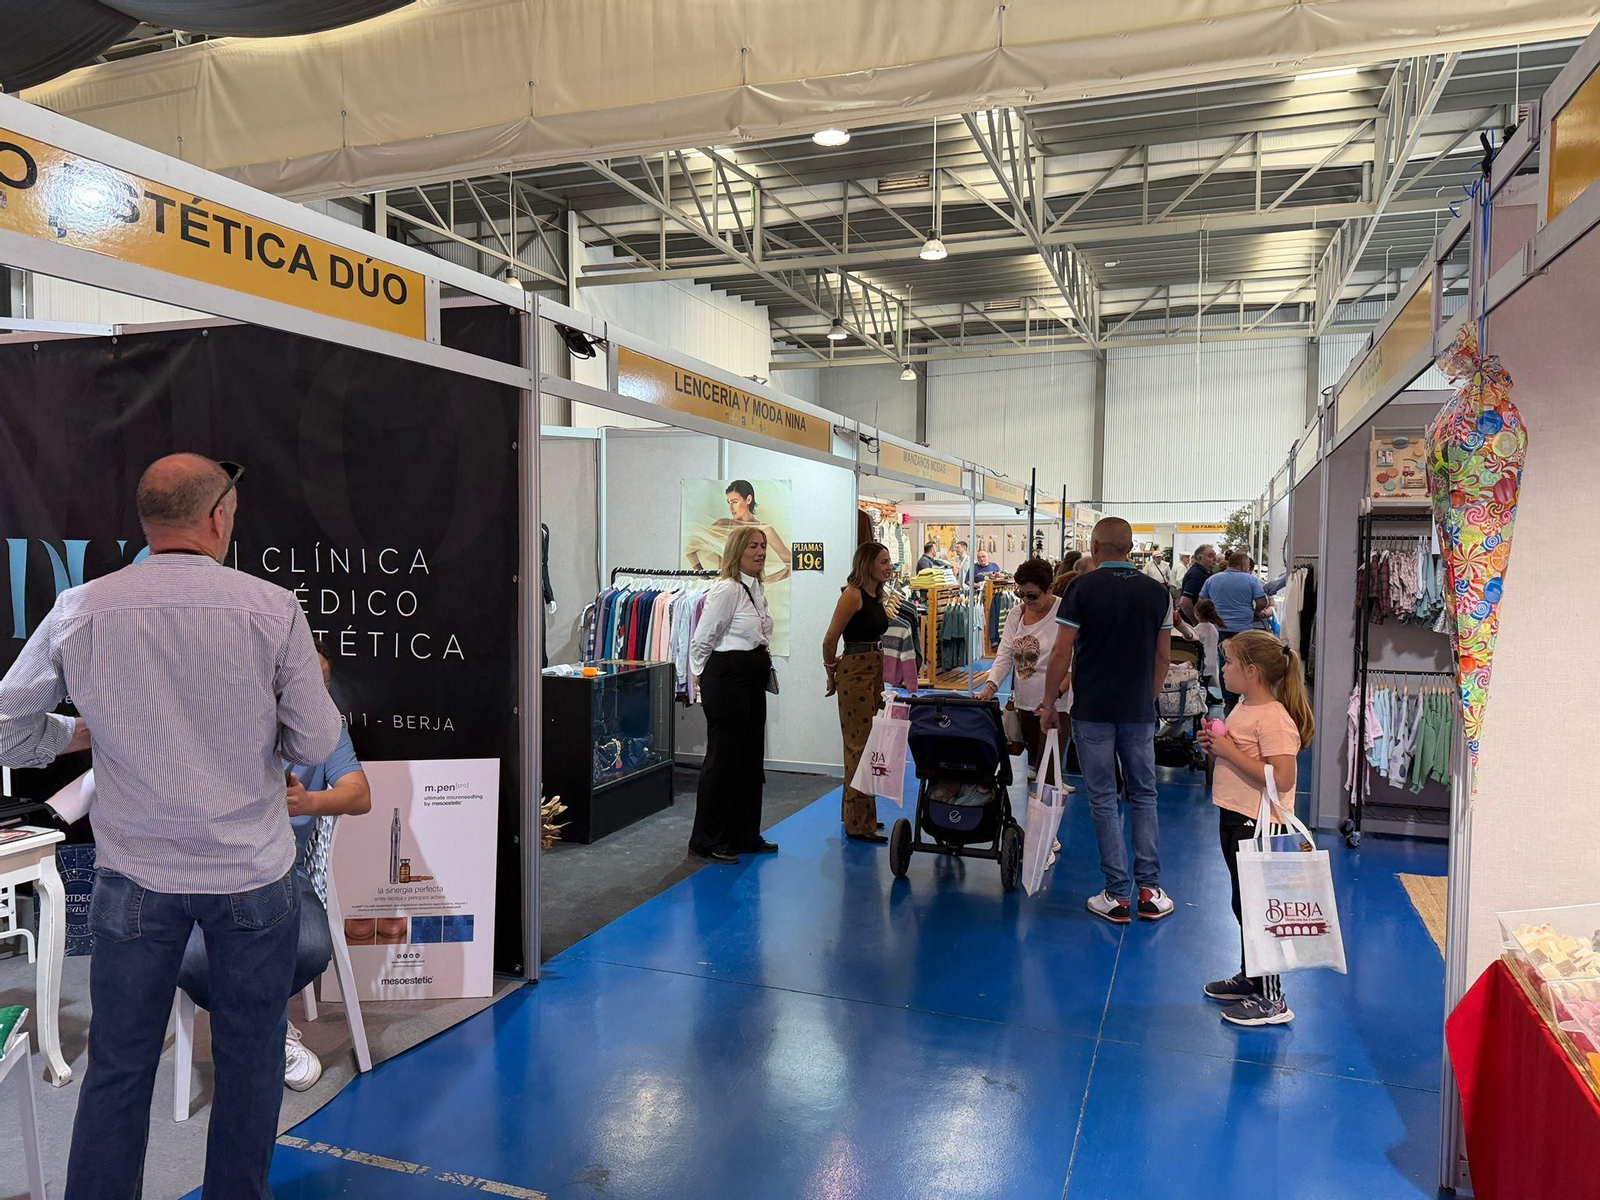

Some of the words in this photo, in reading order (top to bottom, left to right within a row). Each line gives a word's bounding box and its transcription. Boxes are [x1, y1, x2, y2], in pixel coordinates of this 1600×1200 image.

[329, 257, 408, 306] DÚO
[675, 371, 740, 410] LENCERÍA
[742, 393, 750, 413] Y
[752, 398, 783, 426] MODA
[785, 412, 807, 433] NINA
[262, 541, 430, 575] CLÍNICA
[797, 553, 821, 570] 19€
[293, 582, 418, 617] ÉDICO
[312, 624, 465, 660] TÉTICA
[362, 712, 367, 727] 1
[393, 714, 455, 732] BERJA
[424, 784, 456, 794] m.pen
[385, 886, 413, 895] sinergia
[414, 885, 444, 894] perfecta
[1266, 899, 1323, 923] BERJA
[381, 976, 434, 985] mesoestetic
